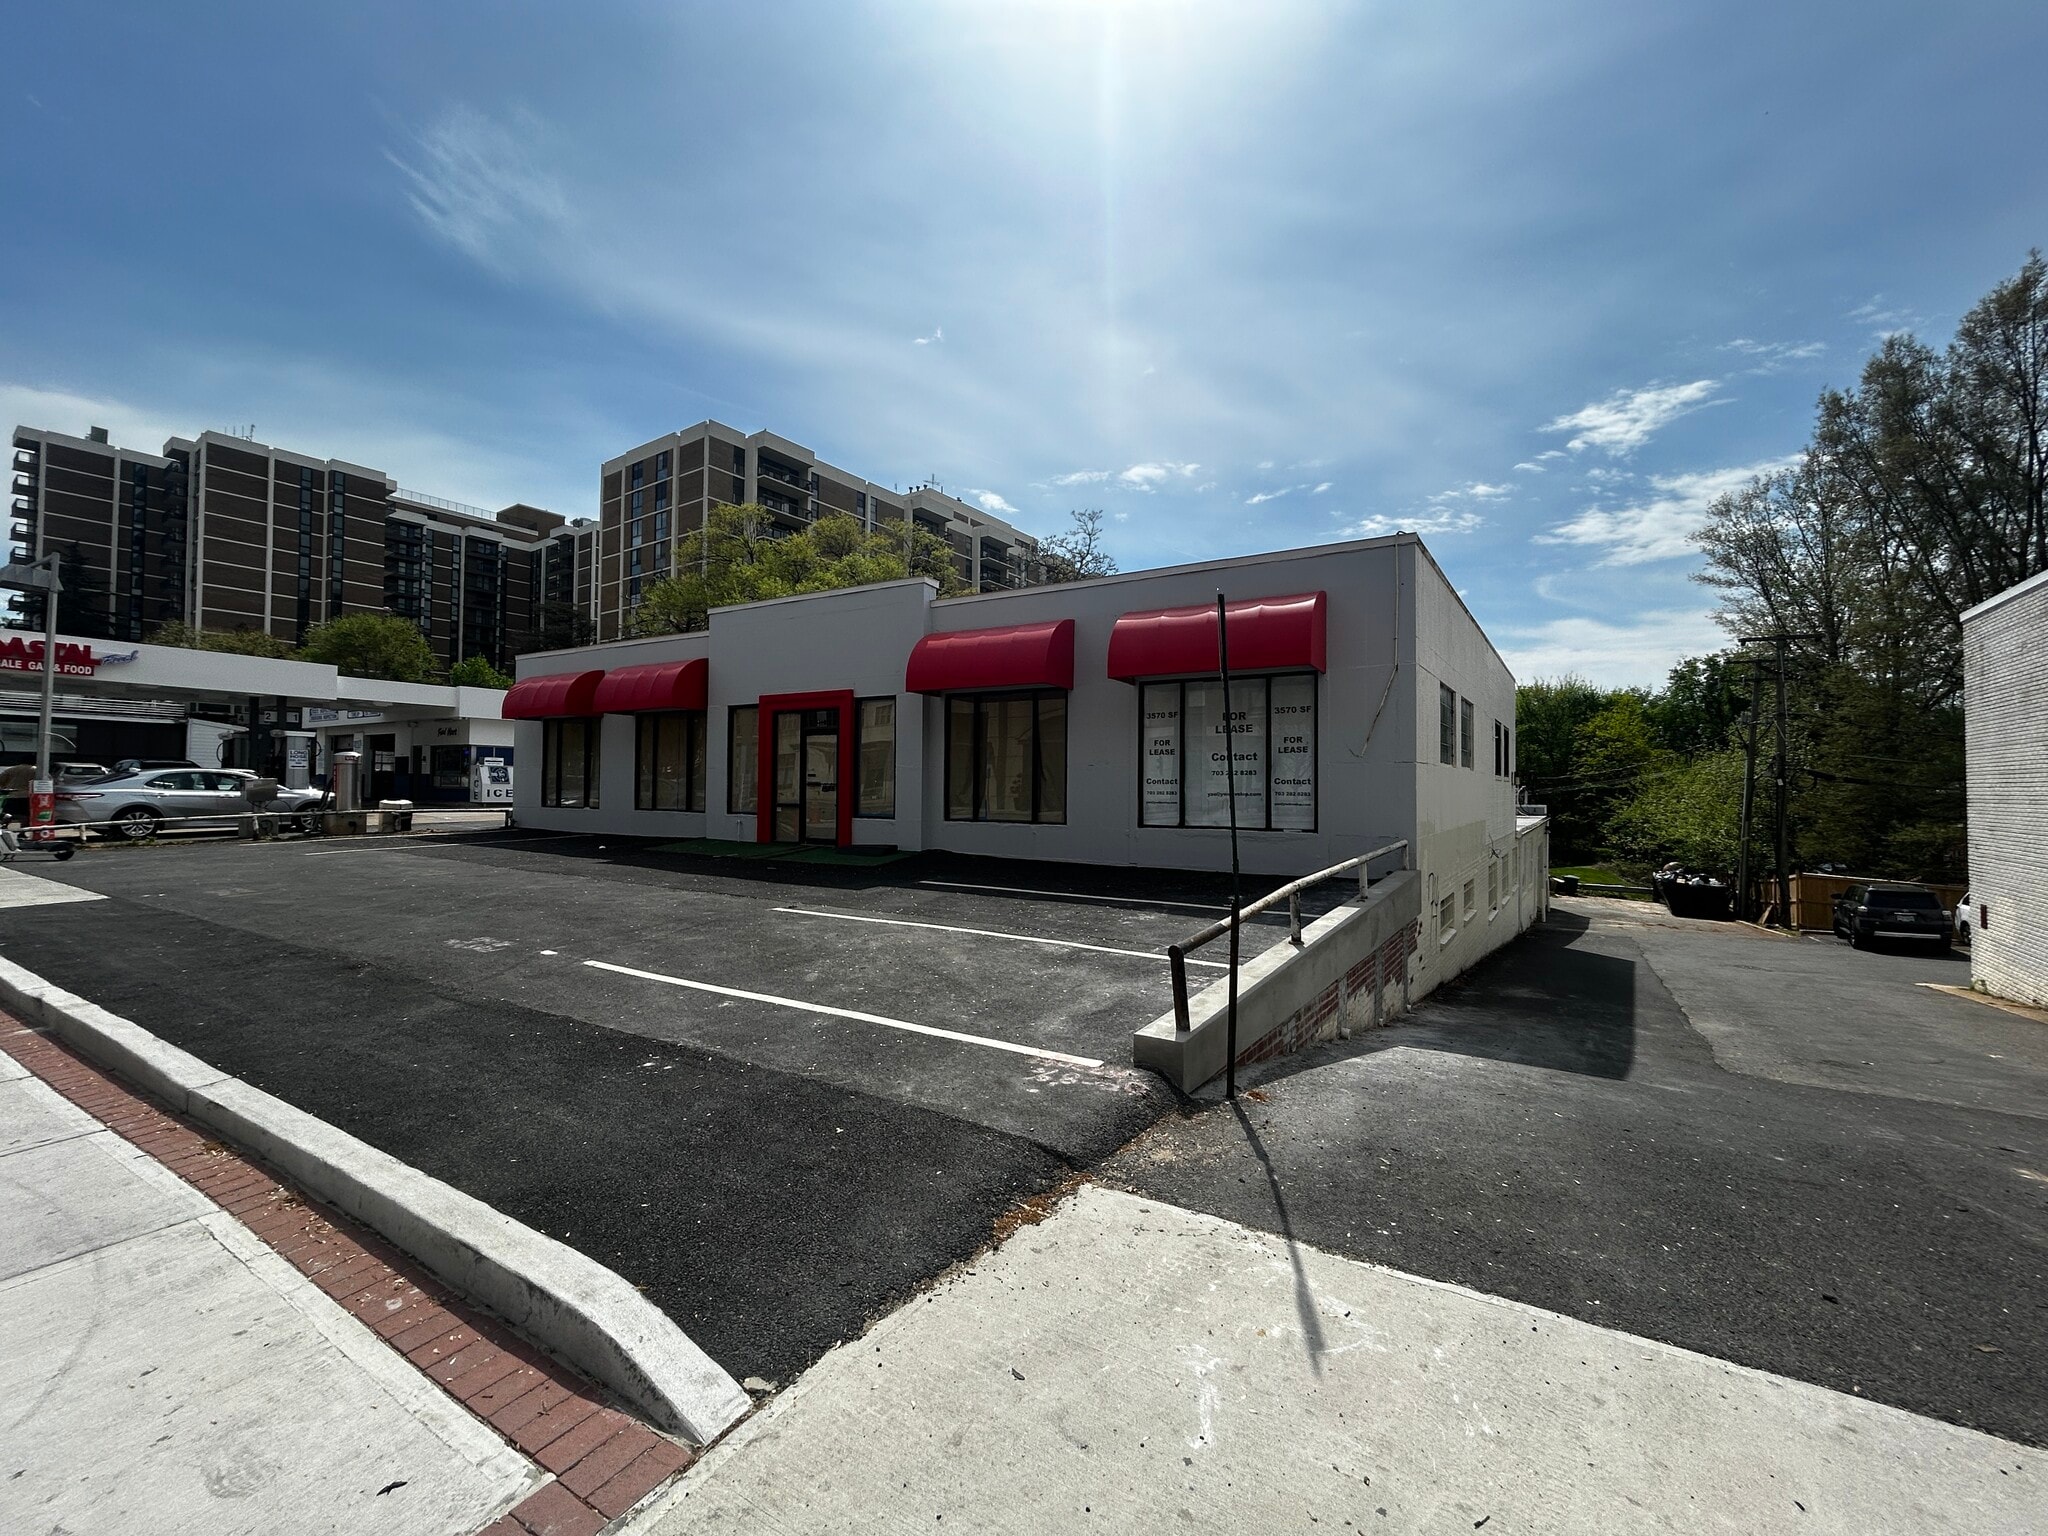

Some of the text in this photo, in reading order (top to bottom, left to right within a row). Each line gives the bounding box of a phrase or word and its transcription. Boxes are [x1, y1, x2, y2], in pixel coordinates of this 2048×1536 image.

[0, 659, 22, 669] ALE
[28, 661, 44, 671] GA
[64, 665, 92, 675] FOOD
[1274, 705, 1312, 714] 3570 SF
[1168, 711, 1178, 719] SF
[1283, 736, 1303, 744] FOR
[1149, 748, 1176, 756] LEASE
[1278, 746, 1308, 754] LEASE
[1211, 752, 1258, 762] Cotact
[486, 789, 513, 798] ICE
